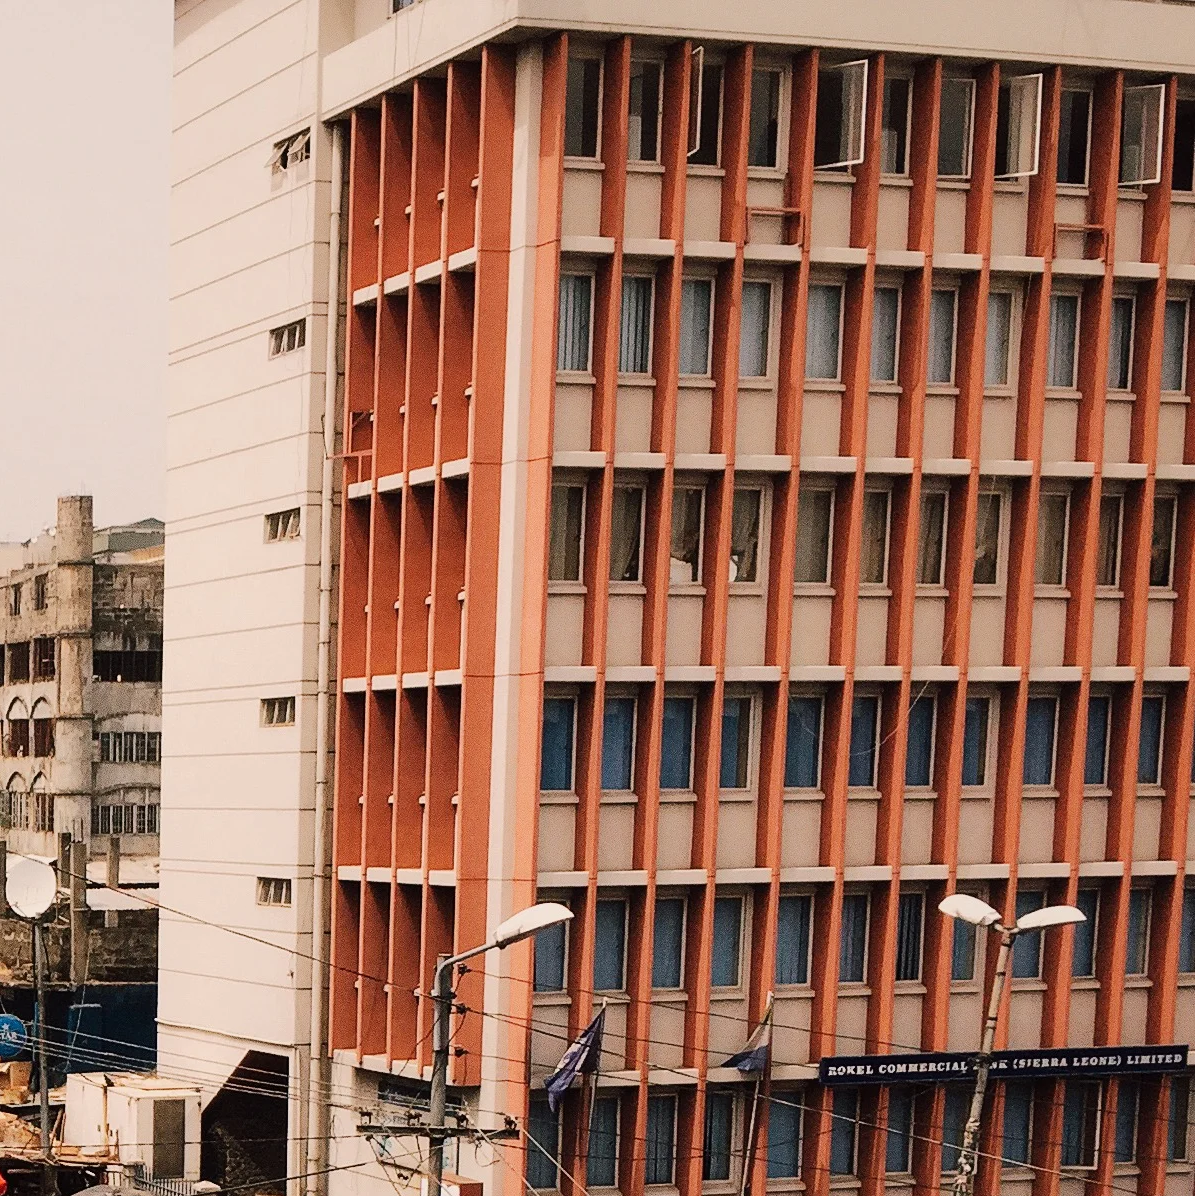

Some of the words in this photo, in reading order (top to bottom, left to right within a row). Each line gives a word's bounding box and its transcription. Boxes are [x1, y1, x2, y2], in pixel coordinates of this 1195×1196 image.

[827, 1065, 874, 1077] ROKEL
[878, 1061, 968, 1074] COMMERCIAL
[1012, 1057, 1068, 1070] (SIERRA
[1072, 1054, 1122, 1067] LEONE)
[1126, 1053, 1183, 1065] LIMITED
